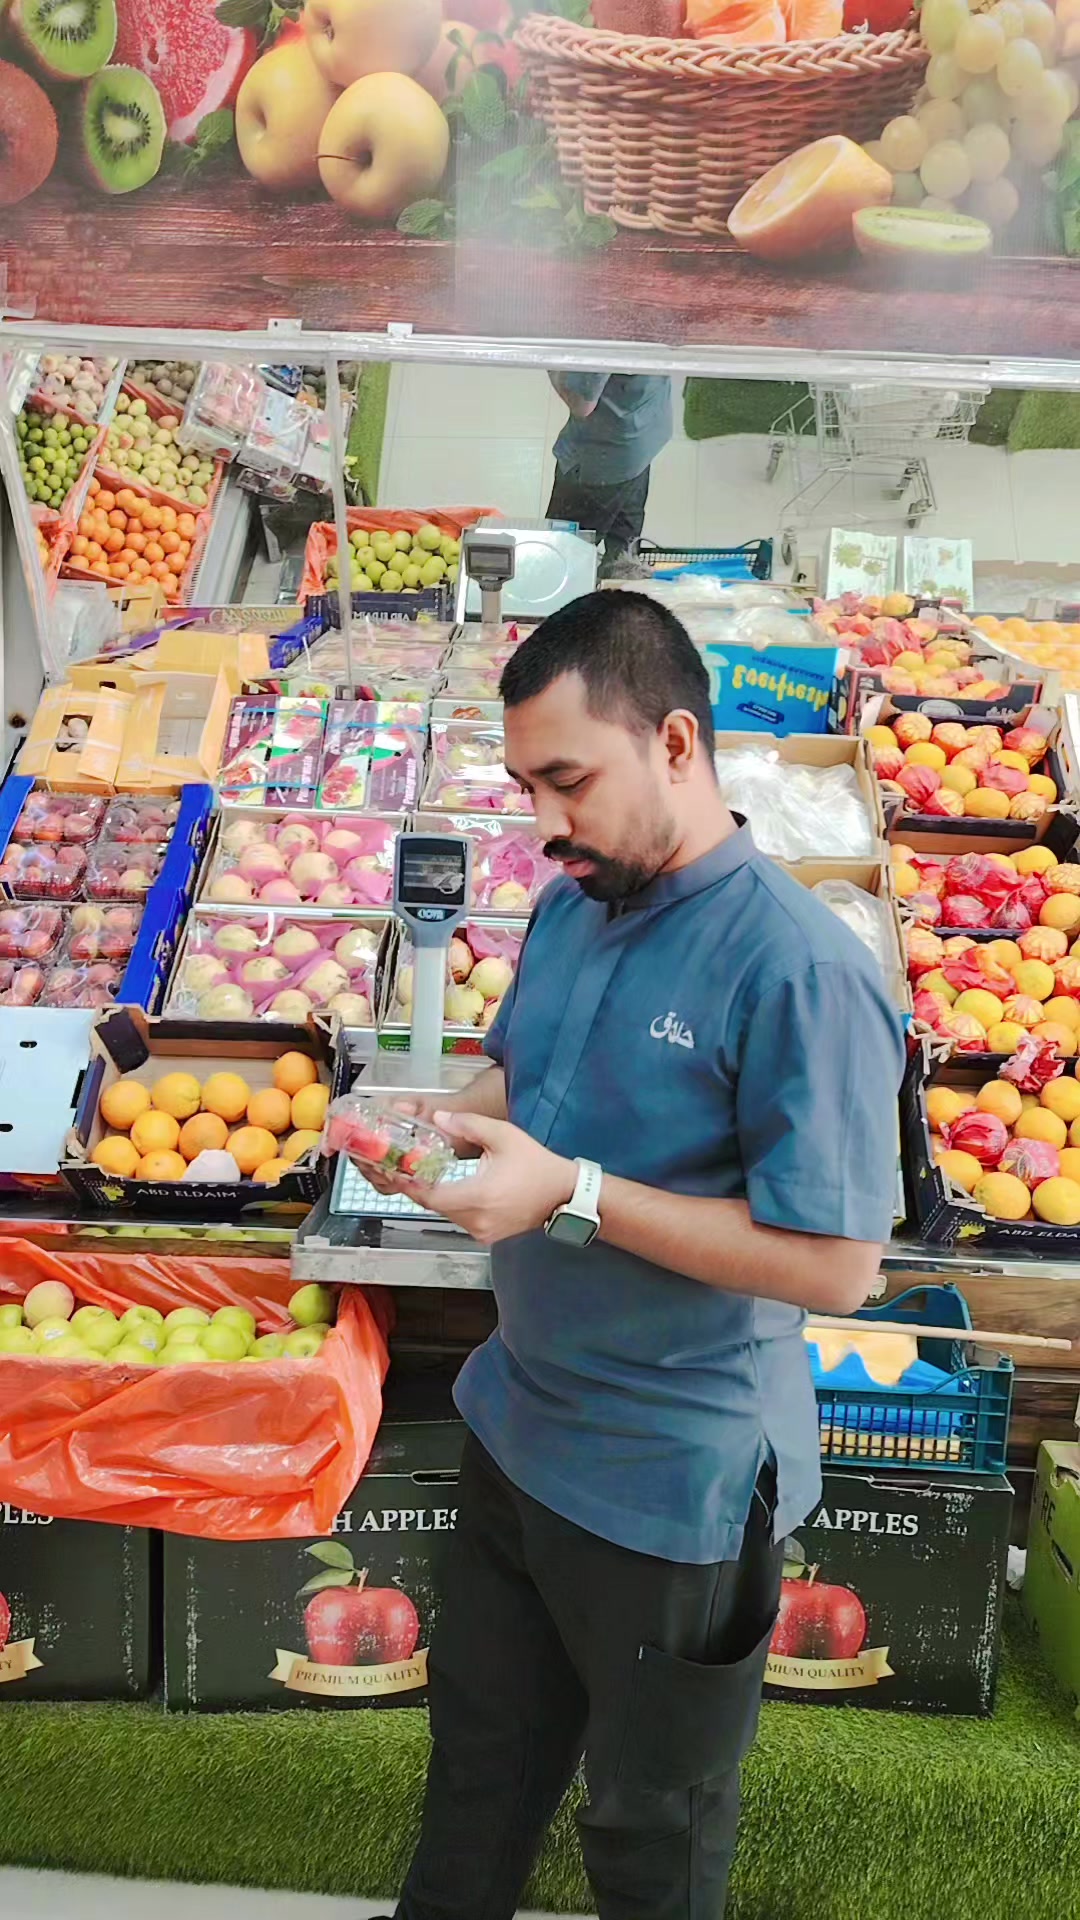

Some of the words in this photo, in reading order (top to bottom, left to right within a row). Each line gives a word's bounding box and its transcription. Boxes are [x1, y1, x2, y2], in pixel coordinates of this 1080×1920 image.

[650, 1011, 694, 1049] حلاق
[137, 1188, 169, 1196] ABD
[174, 1190, 237, 1199] ELDAIM
[811, 1507, 919, 1536] APPLES
[295, 1669, 359, 1685] PREMIUM
[363, 1665, 422, 1686] QUALITY
[807, 1666, 866, 1679] QUALITY
